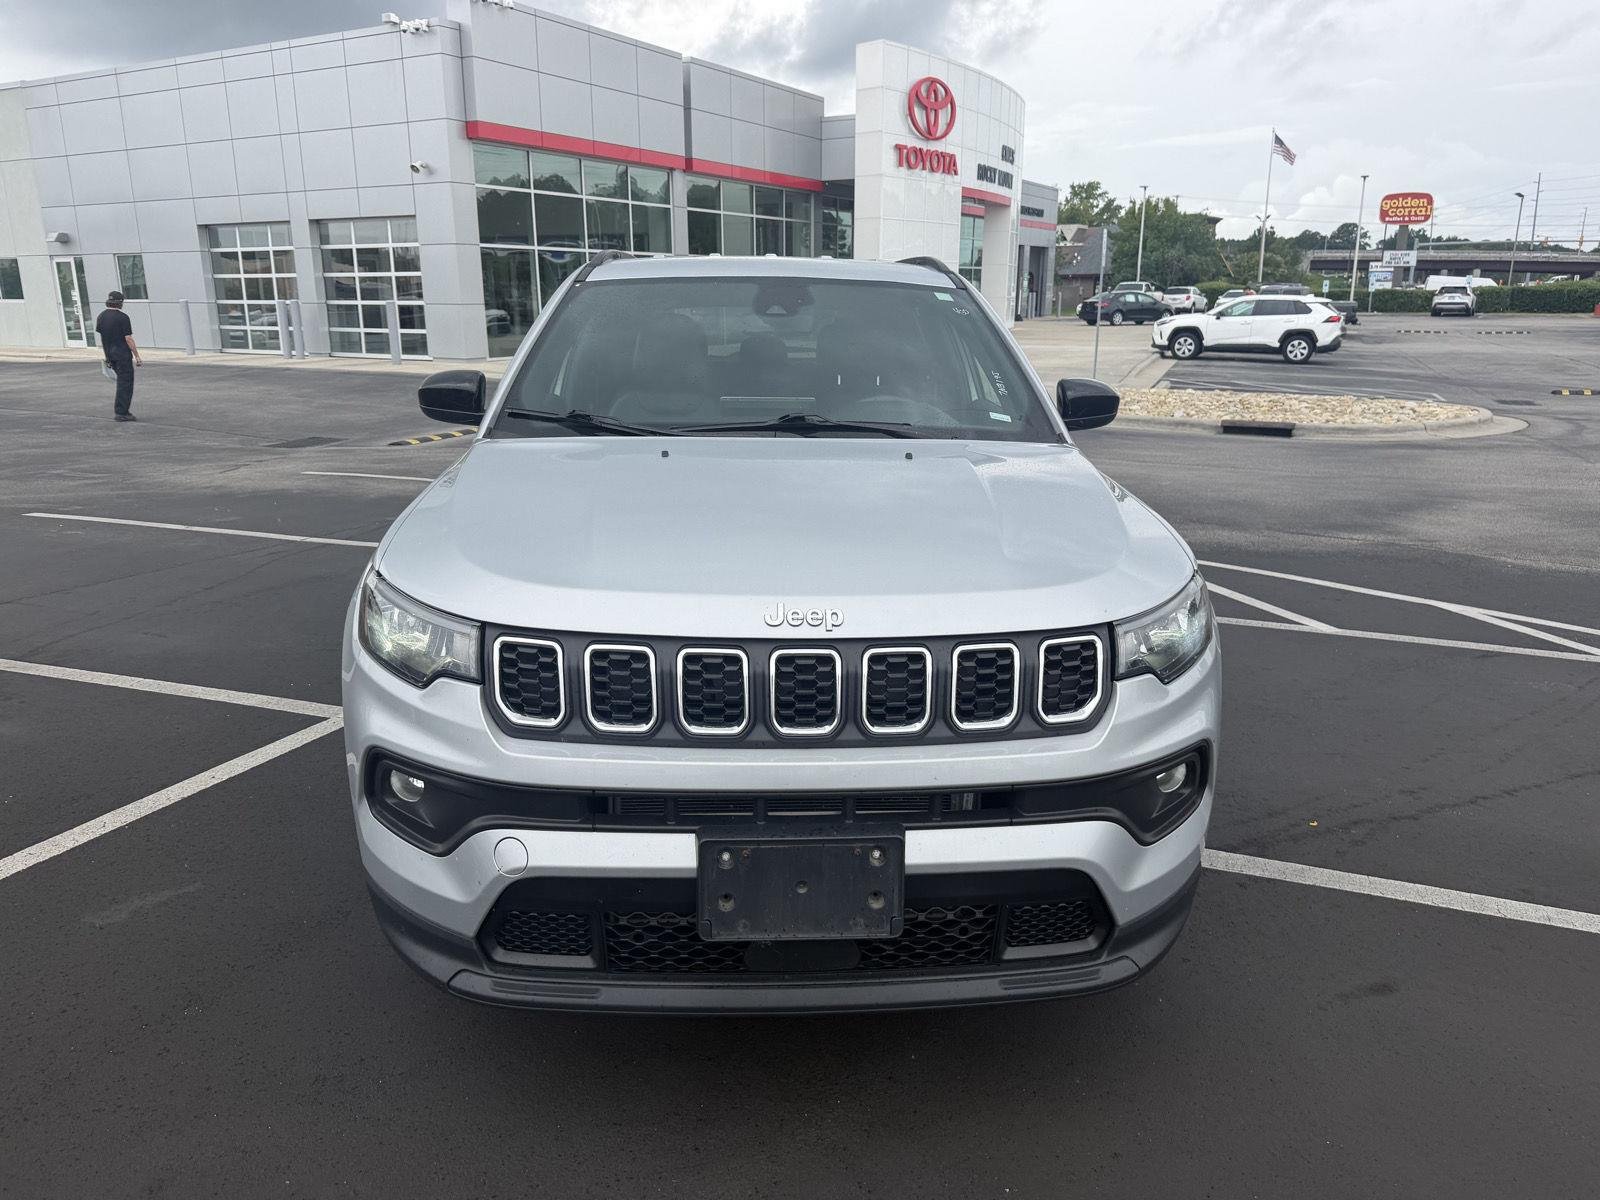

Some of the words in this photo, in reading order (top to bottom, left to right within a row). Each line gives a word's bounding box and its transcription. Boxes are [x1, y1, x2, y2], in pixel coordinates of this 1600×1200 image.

[894, 143, 959, 176] TOYOTA
[1382, 197, 1428, 210] golden
[1388, 206, 1432, 216] corral
[764, 601, 844, 632] Jeep
